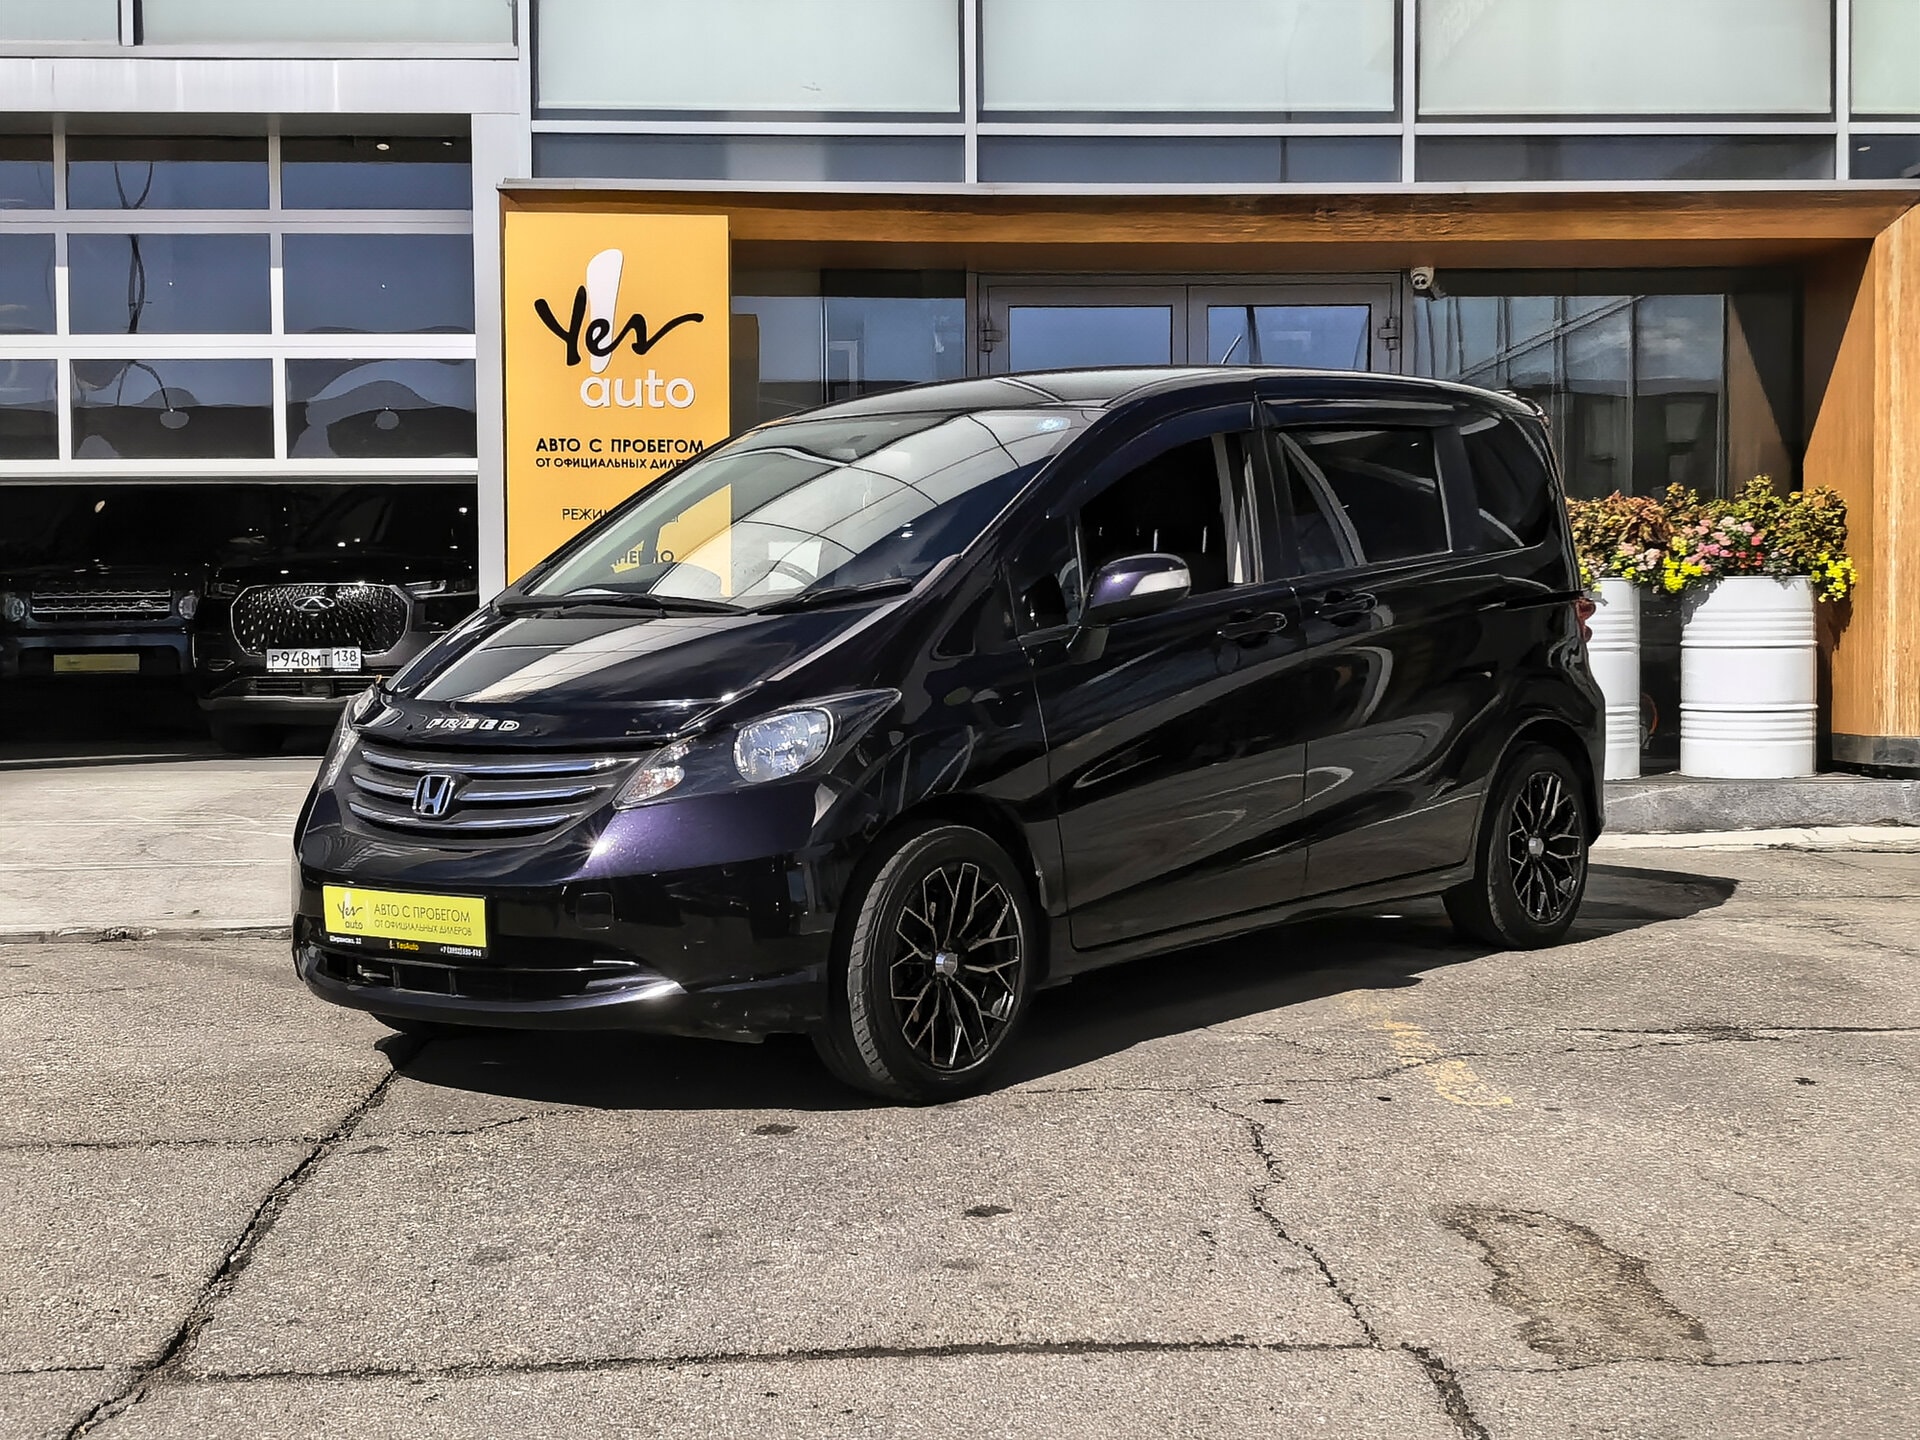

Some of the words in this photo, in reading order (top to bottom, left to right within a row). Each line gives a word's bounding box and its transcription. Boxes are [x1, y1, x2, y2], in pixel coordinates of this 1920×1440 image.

[580, 369, 696, 409] auto
[535, 438, 581, 453] АВТО
[589, 438, 602, 453] С
[611, 438, 704, 454] ПРОБЕГОМ
[535, 457, 551, 468] ОТ
[554, 457, 647, 469] ОФИЦИАЛЬНЫХ
[562, 508, 609, 521] РЕЖИ
[334, 650, 357, 662] 138
[425, 718, 521, 732] FREED
[374, 903, 400, 917] АВТО
[402, 905, 411, 918] С
[413, 906, 471, 923] ПРОБЕГОМ
[344, 920, 364, 930] auto
[374, 919, 383, 928] ОТ
[385, 920, 438, 934] ОФИЦИАЛЬНЫХ
[439, 925, 472, 937] ДИЛЕРОВ
